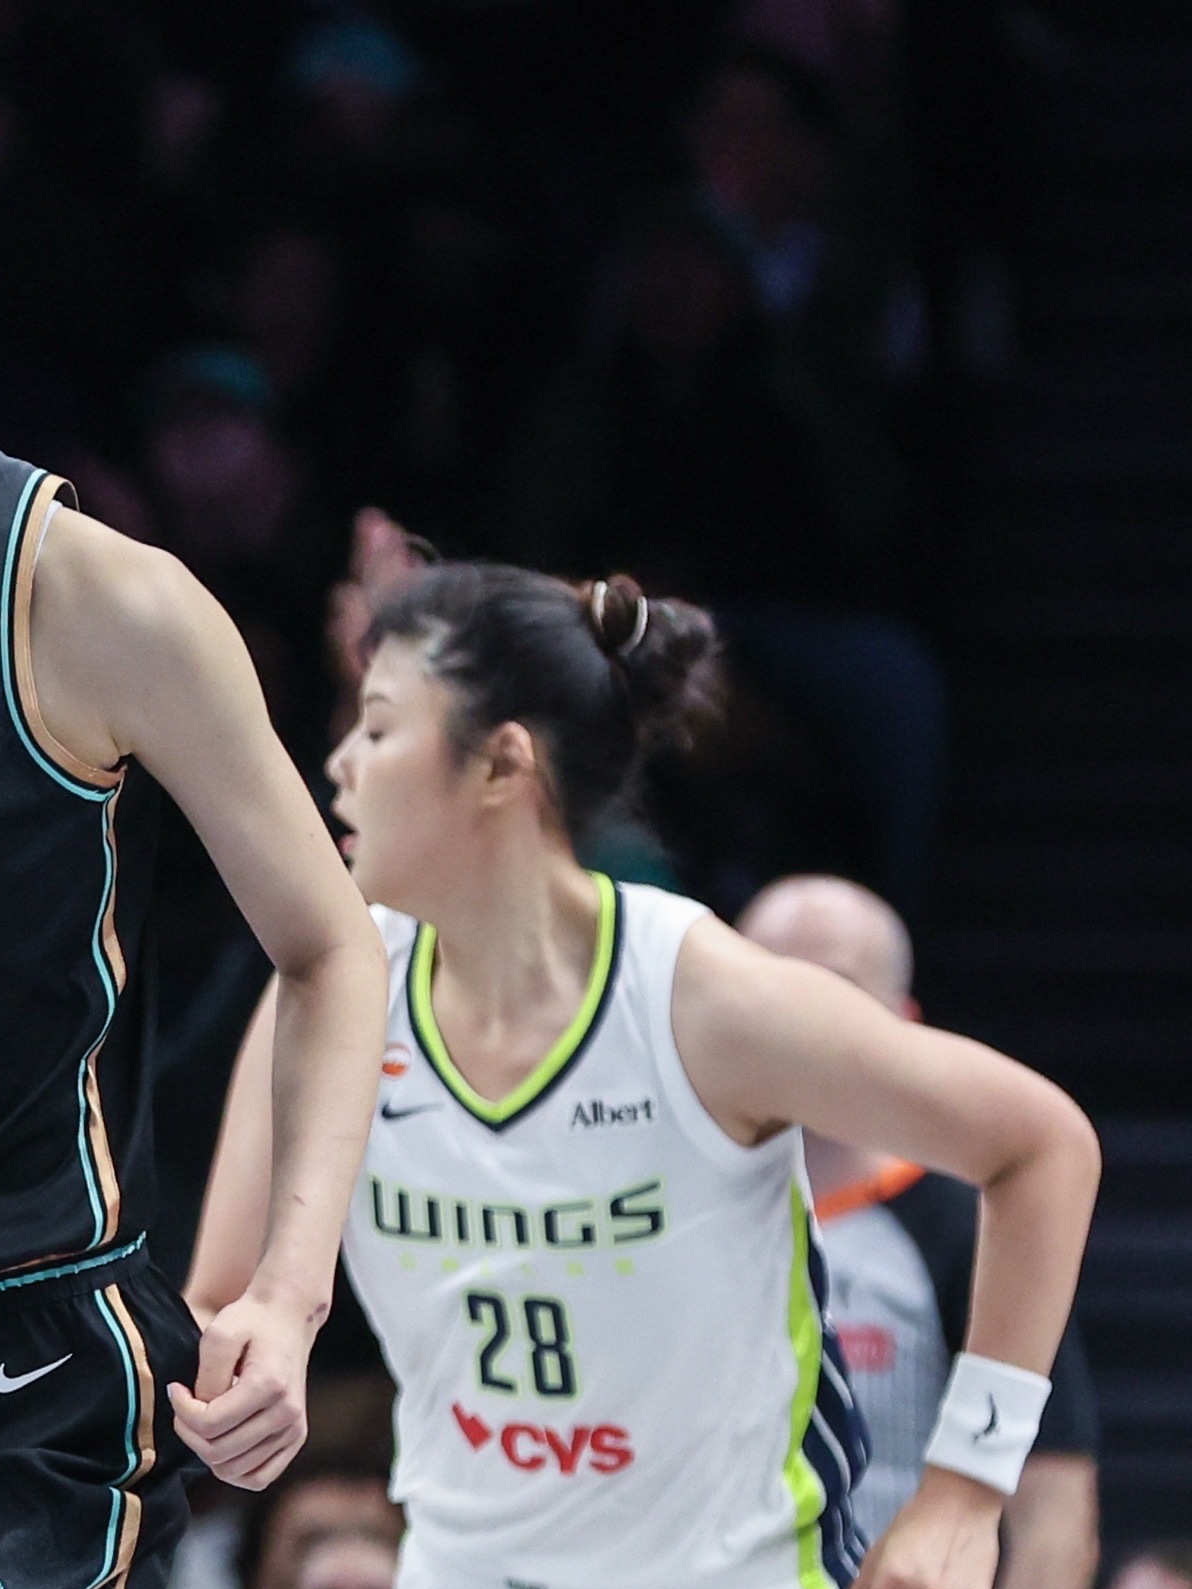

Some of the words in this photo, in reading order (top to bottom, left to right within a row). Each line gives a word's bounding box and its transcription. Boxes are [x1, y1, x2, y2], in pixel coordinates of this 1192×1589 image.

[571, 1099, 655, 1129] Albert
[465, 1291, 579, 1401] 28
[501, 1422, 635, 1475] CVS
